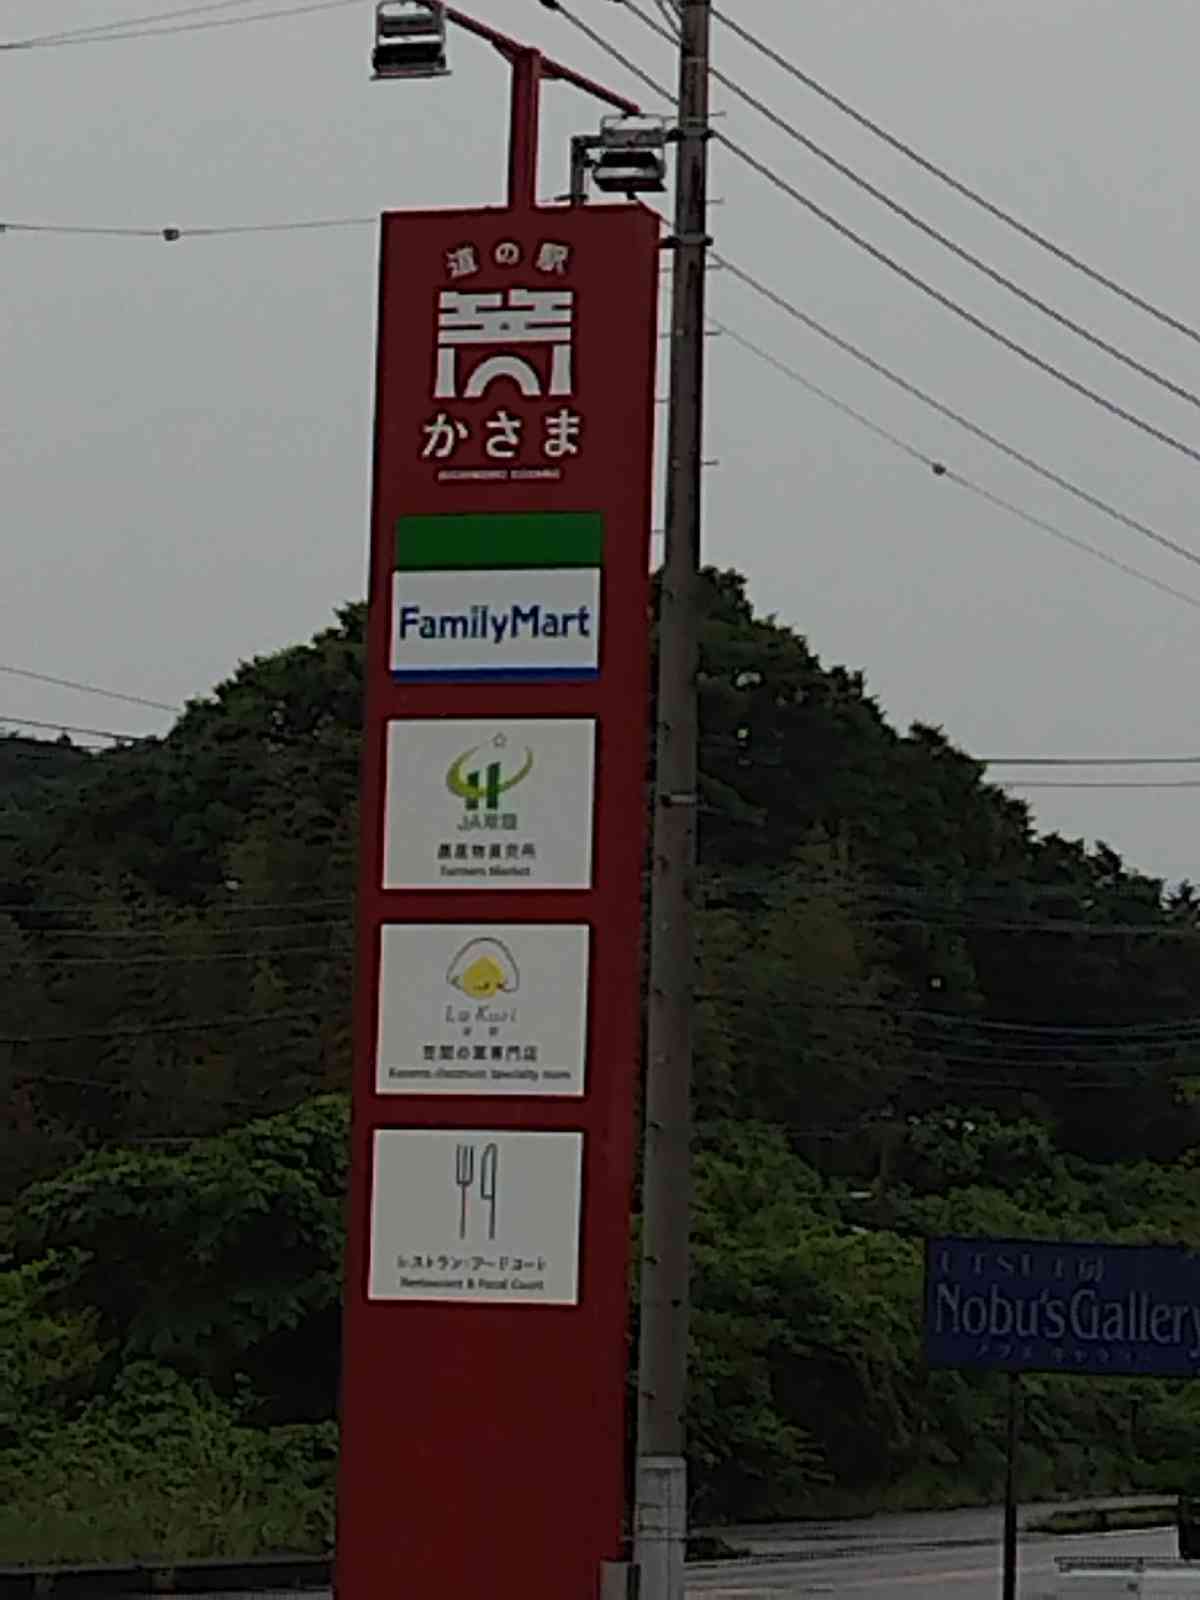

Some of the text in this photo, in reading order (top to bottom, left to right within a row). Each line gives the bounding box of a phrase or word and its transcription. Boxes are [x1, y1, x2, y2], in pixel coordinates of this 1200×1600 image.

[446, 242, 569, 277] 道の駅
[421, 409, 580, 458] かさま
[399, 604, 591, 643] FamilyMart
